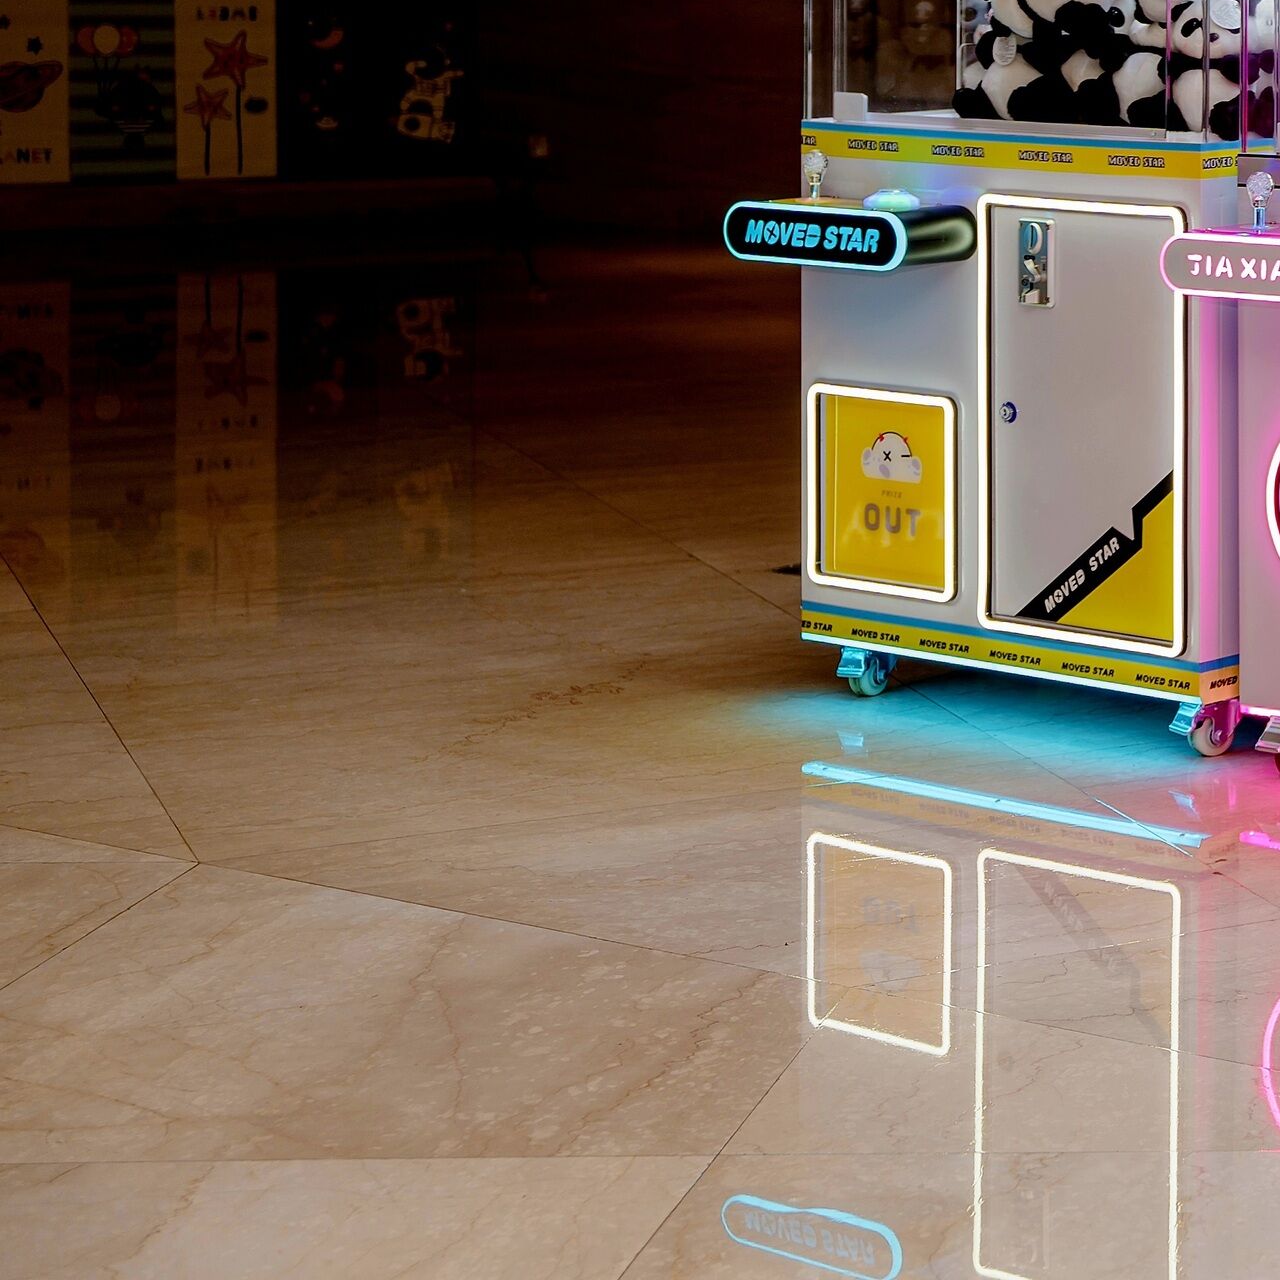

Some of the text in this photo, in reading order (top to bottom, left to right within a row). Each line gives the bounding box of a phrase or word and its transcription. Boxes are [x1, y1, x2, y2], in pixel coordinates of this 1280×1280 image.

[848, 139, 899, 152] MOVED STAR
[932, 144, 984, 157] MOVED STAR
[1018, 150, 1073, 163] MOVED STAR
[1108, 154, 1165, 169] MOVED STAR
[1203, 157, 1232, 169] MOVED
[745, 219, 880, 254] MOVED STAR
[1188, 253, 1233, 280] JIA
[864, 502, 921, 537] OUT
[1043, 536, 1121, 613] MOVED STAR
[813, 621, 832, 632] STAR
[851, 627, 900, 643] MOVED STAR
[919, 637, 970, 653] MOVED STAR
[989, 649, 1041, 665] MOVED STAR
[1061, 661, 1115, 677] MOVED STAR
[1135, 673, 1190, 690] MOVED STAR
[1209, 675, 1238, 689] MOVED
